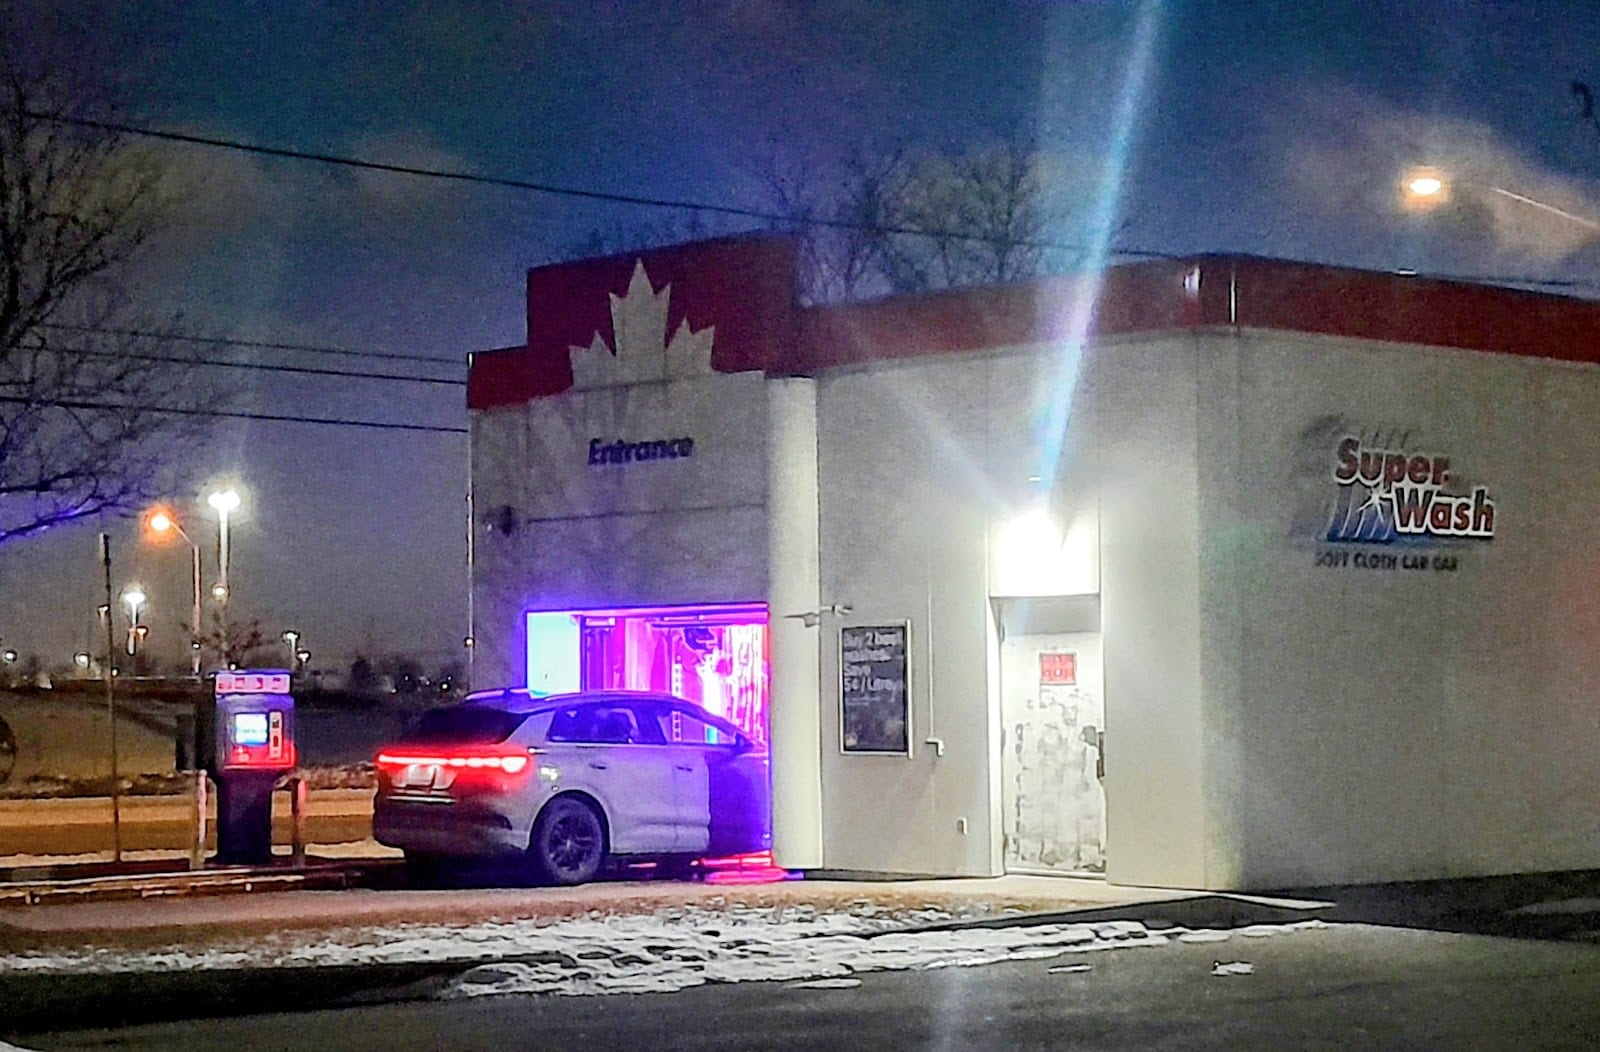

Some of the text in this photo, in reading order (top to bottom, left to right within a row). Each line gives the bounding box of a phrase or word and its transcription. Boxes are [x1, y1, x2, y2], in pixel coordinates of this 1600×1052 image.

[588, 437, 694, 465] Entrance
[1335, 436, 1451, 488] Super
[1393, 485, 1495, 538] Wash
[1314, 550, 1350, 568] SOFT
[1353, 552, 1398, 570] CLOTH
